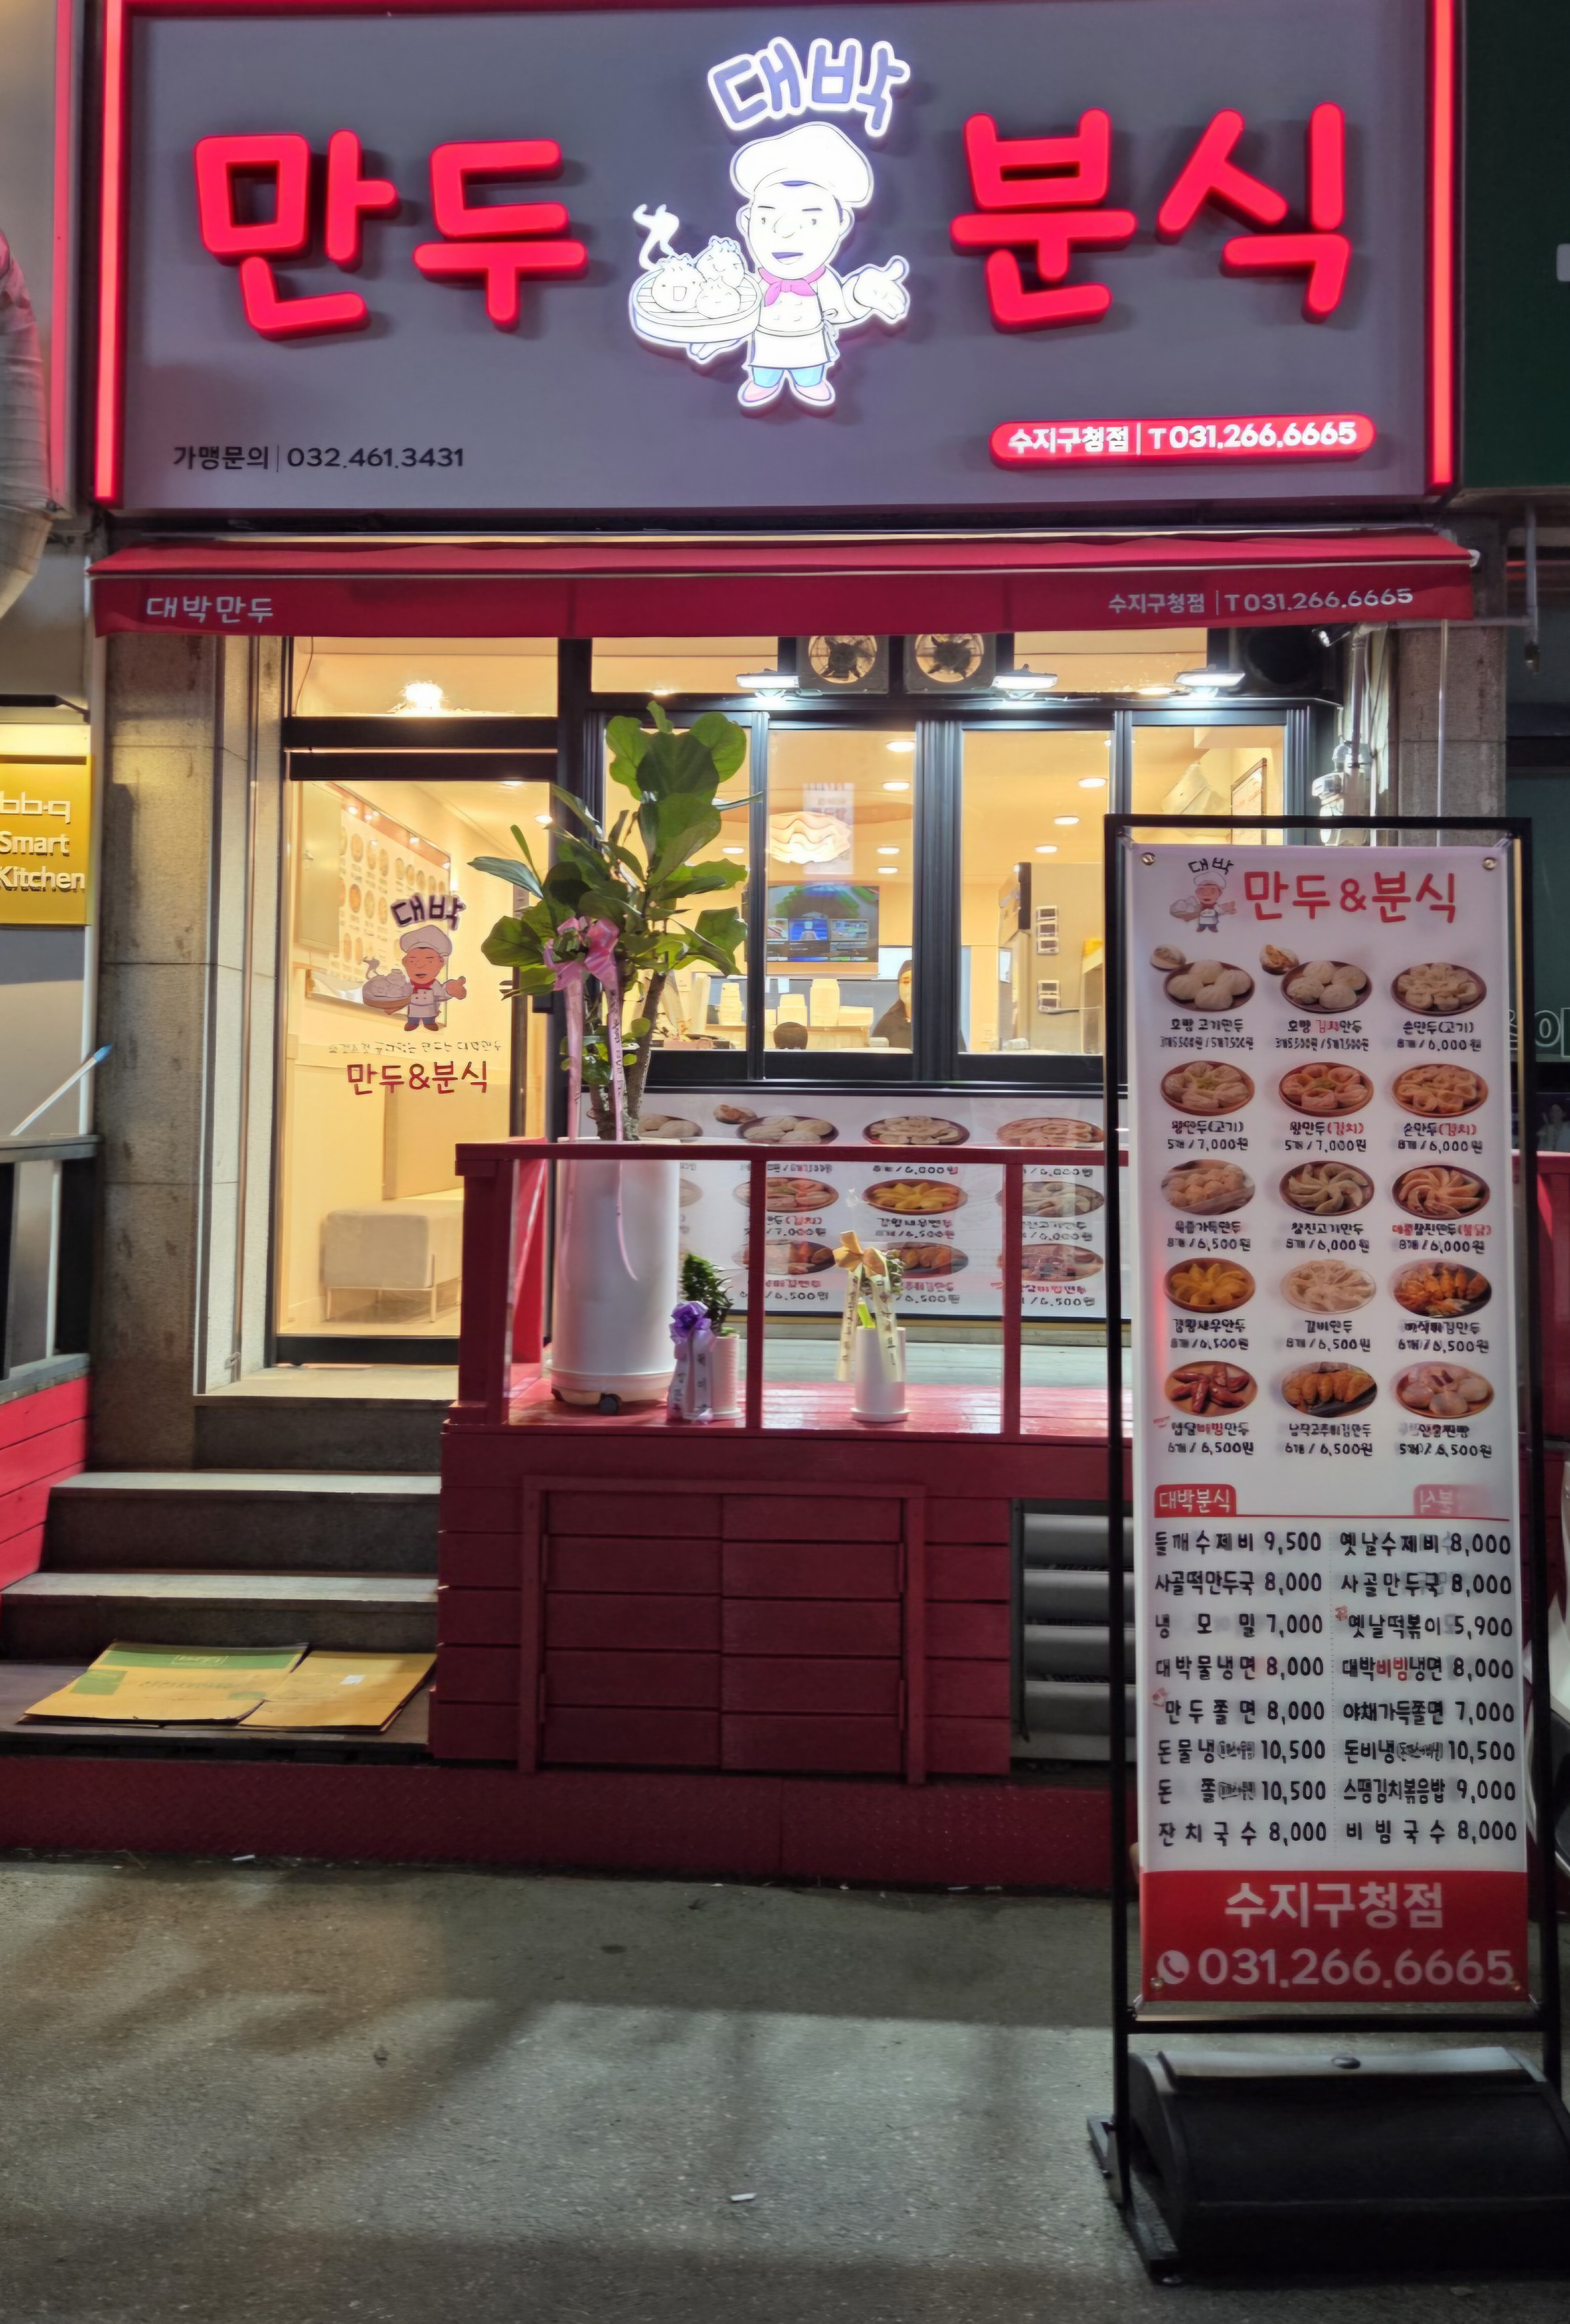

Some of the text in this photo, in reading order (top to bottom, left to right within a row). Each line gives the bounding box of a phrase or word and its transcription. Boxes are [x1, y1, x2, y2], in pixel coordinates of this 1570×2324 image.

[708, 36, 910, 137] 대박
[194, 102, 1351, 340] 만두 분식
[1008, 426, 1129, 454] 수지구청점
[172, 445, 464, 470] 가맹문의 032.461.3431
[146, 595, 273, 623] 대박만두
[1108, 593, 1204, 613] 수지구청점
[0, 831, 70, 857] Smart
[1188, 857, 1234, 875] 대박
[390, 893, 467, 930] 대박
[347, 1060, 487, 1095] 만두&분식
[1159, 1489, 1230, 1513] 대박분식
[1264, 1531, 1321, 1555] 9,500
[1451, 1533, 1511, 1557] 8,000
[1155, 1571, 1322, 1596] 사골떡만두국 8,000
[1452, 1573, 1511, 1597] 8,000
[1266, 1614, 1323, 1638] 7,000
[1348, 1614, 1513, 1640] 옛날떡볶이 5,900
[1267, 1656, 1324, 1680] 8,000
[1342, 1657, 1513, 1682] 대박비빔냉면 8,000
[1268, 1701, 1324, 1725] 8,000
[1343, 1700, 1514, 1725] 야채가득쫄면 7,000
[1261, 1739, 1325, 1764] 10,500
[1448, 1740, 1515, 1764] 10,500
[1261, 1780, 1326, 1805] 10,500
[1457, 1779, 1515, 1804] 9,000
[1269, 1821, 1326, 1846] 8,000
[1458, 1820, 1516, 1845] 8,000
[1224, 1882, 1444, 1930] 수지구청점
[1198, 1948, 1514, 1988] 031.266.6665
